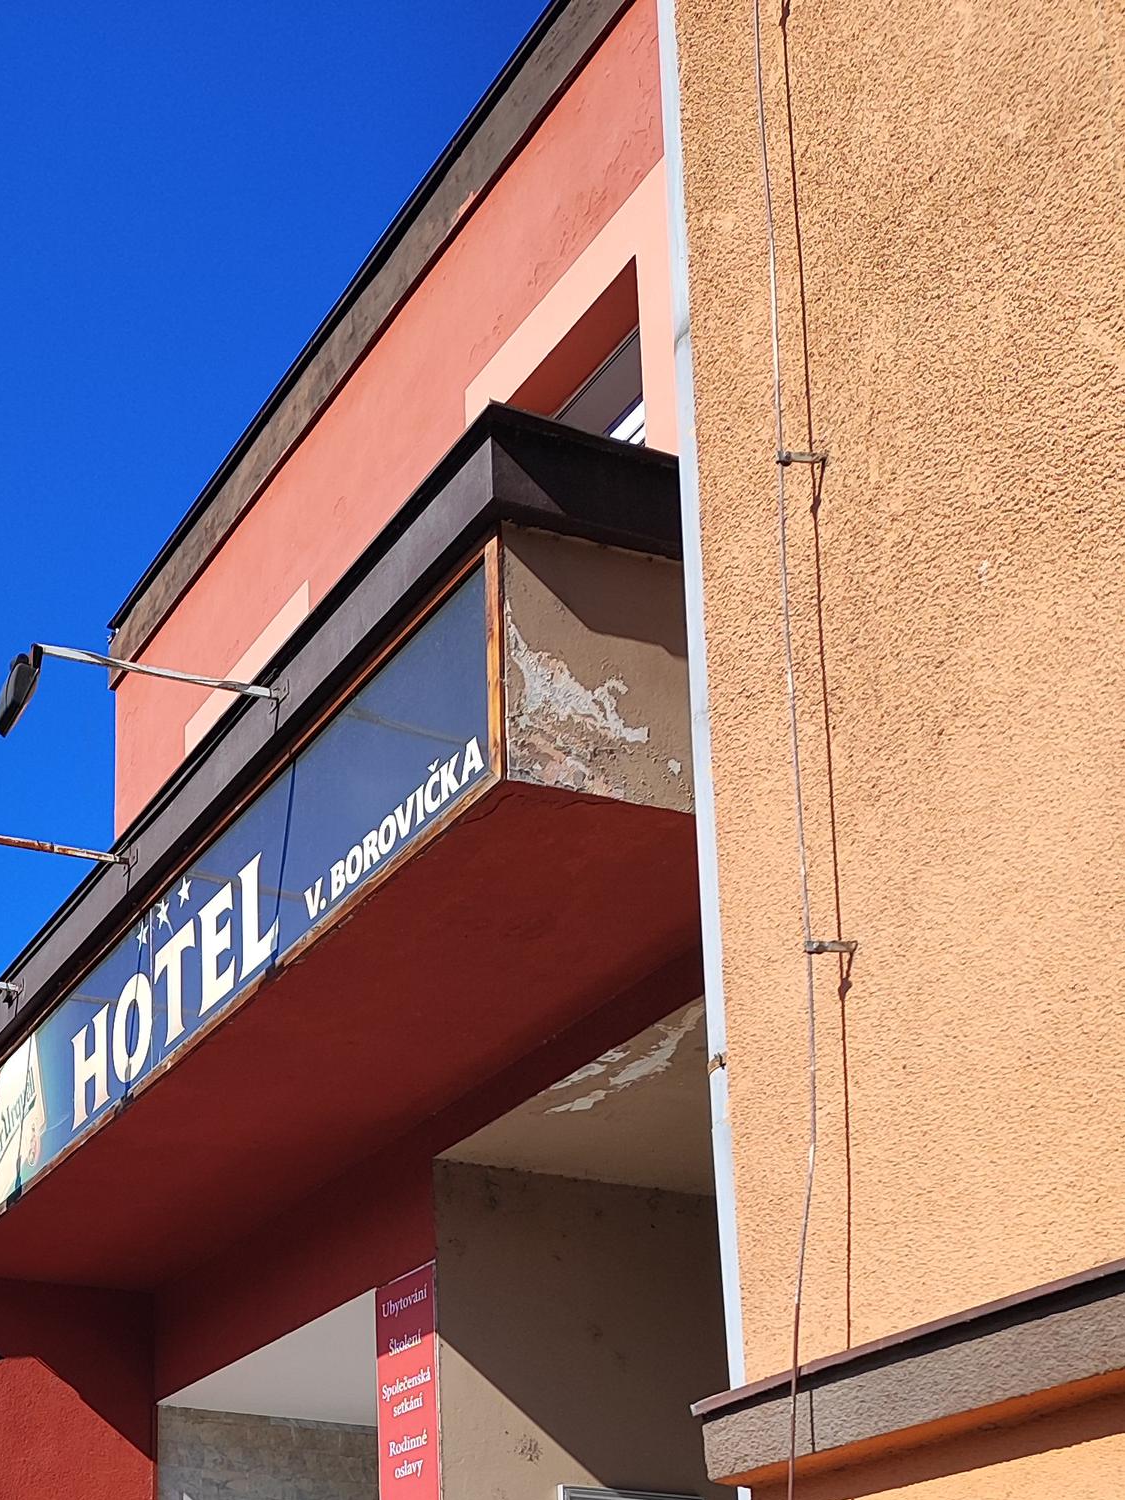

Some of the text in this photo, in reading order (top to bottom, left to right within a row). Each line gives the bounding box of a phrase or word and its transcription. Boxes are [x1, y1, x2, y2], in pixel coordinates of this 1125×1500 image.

[303, 736, 485, 921] V. BOROVIČKA
[71, 851, 279, 1132] HOTEL
[382, 1283, 428, 1318] Ubytování
[388, 1328, 422, 1357] Školení
[382, 1367, 431, 1402] Společenská
[393, 1392, 423, 1417] setkání
[389, 1429, 427, 1457] Rodinné
[394, 1458, 424, 1480] oslavy
